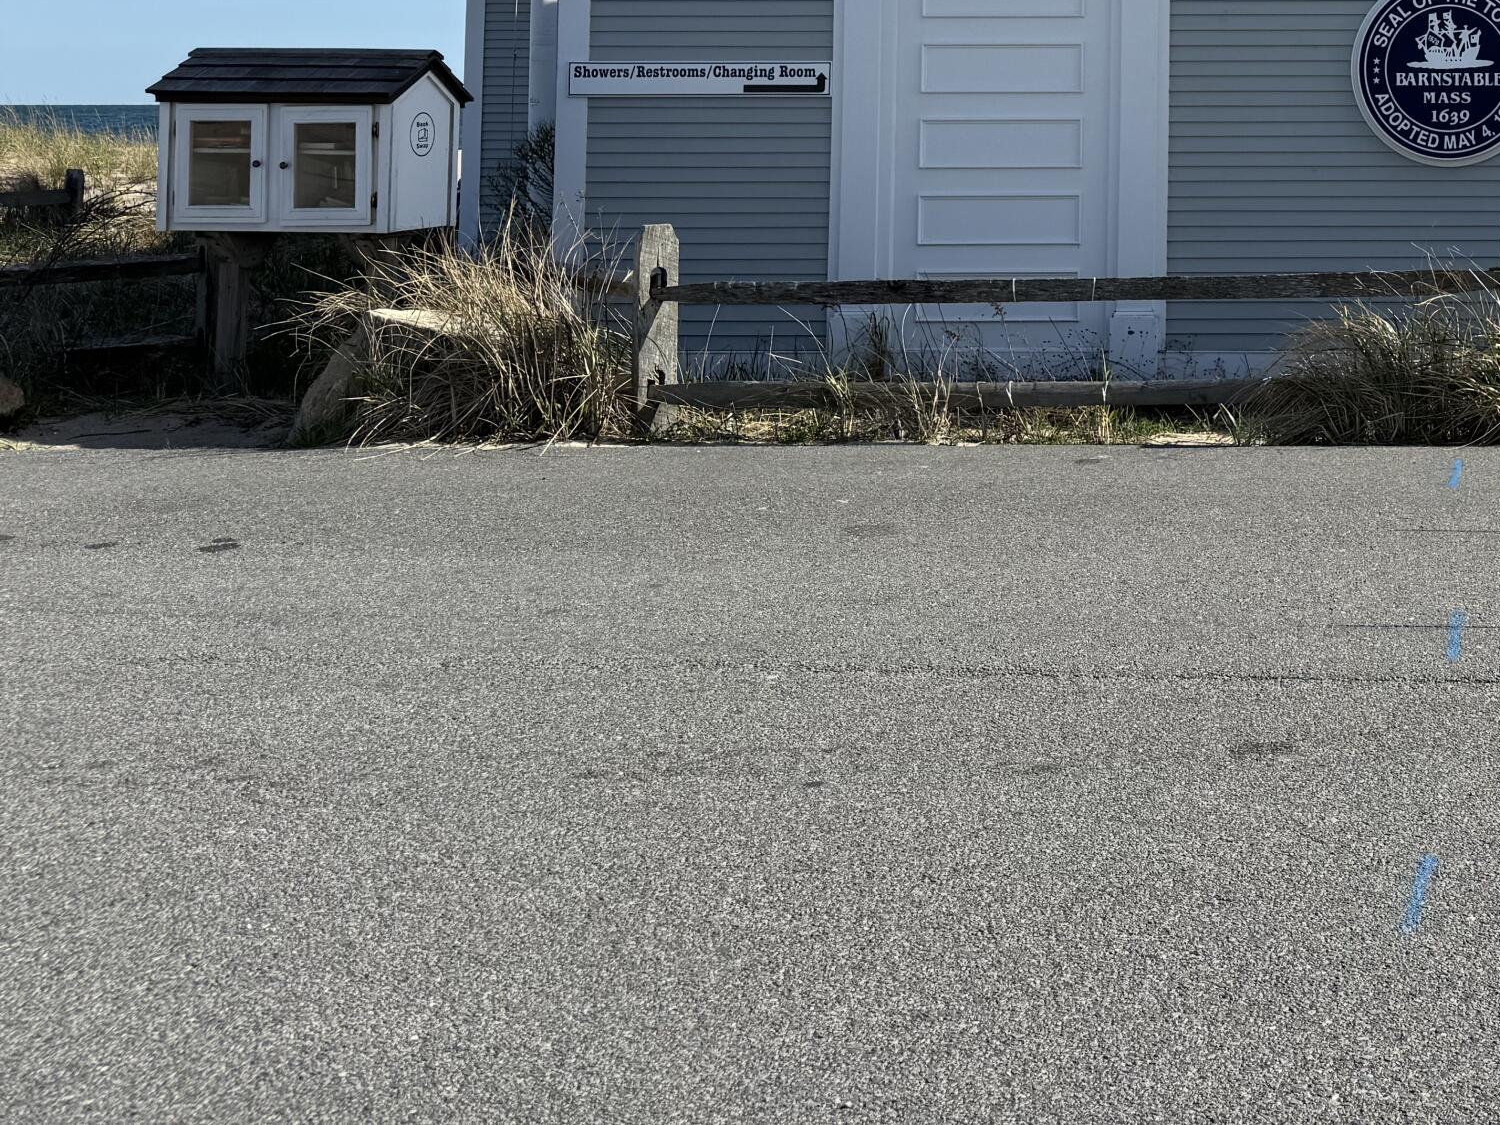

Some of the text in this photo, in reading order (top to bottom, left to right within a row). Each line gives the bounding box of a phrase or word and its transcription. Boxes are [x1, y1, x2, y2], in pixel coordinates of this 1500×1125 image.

[1373, 6, 1411, 49] SEAL
[779, 65, 816, 79] Room
[1423, 91, 1472, 104] MASS
[1374, 92, 1440, 149] ADOPTED
[1443, 129, 1476, 150] MAY
[1482, 125, 1496, 139] 4,
[1431, 108, 1470, 125] 1639
